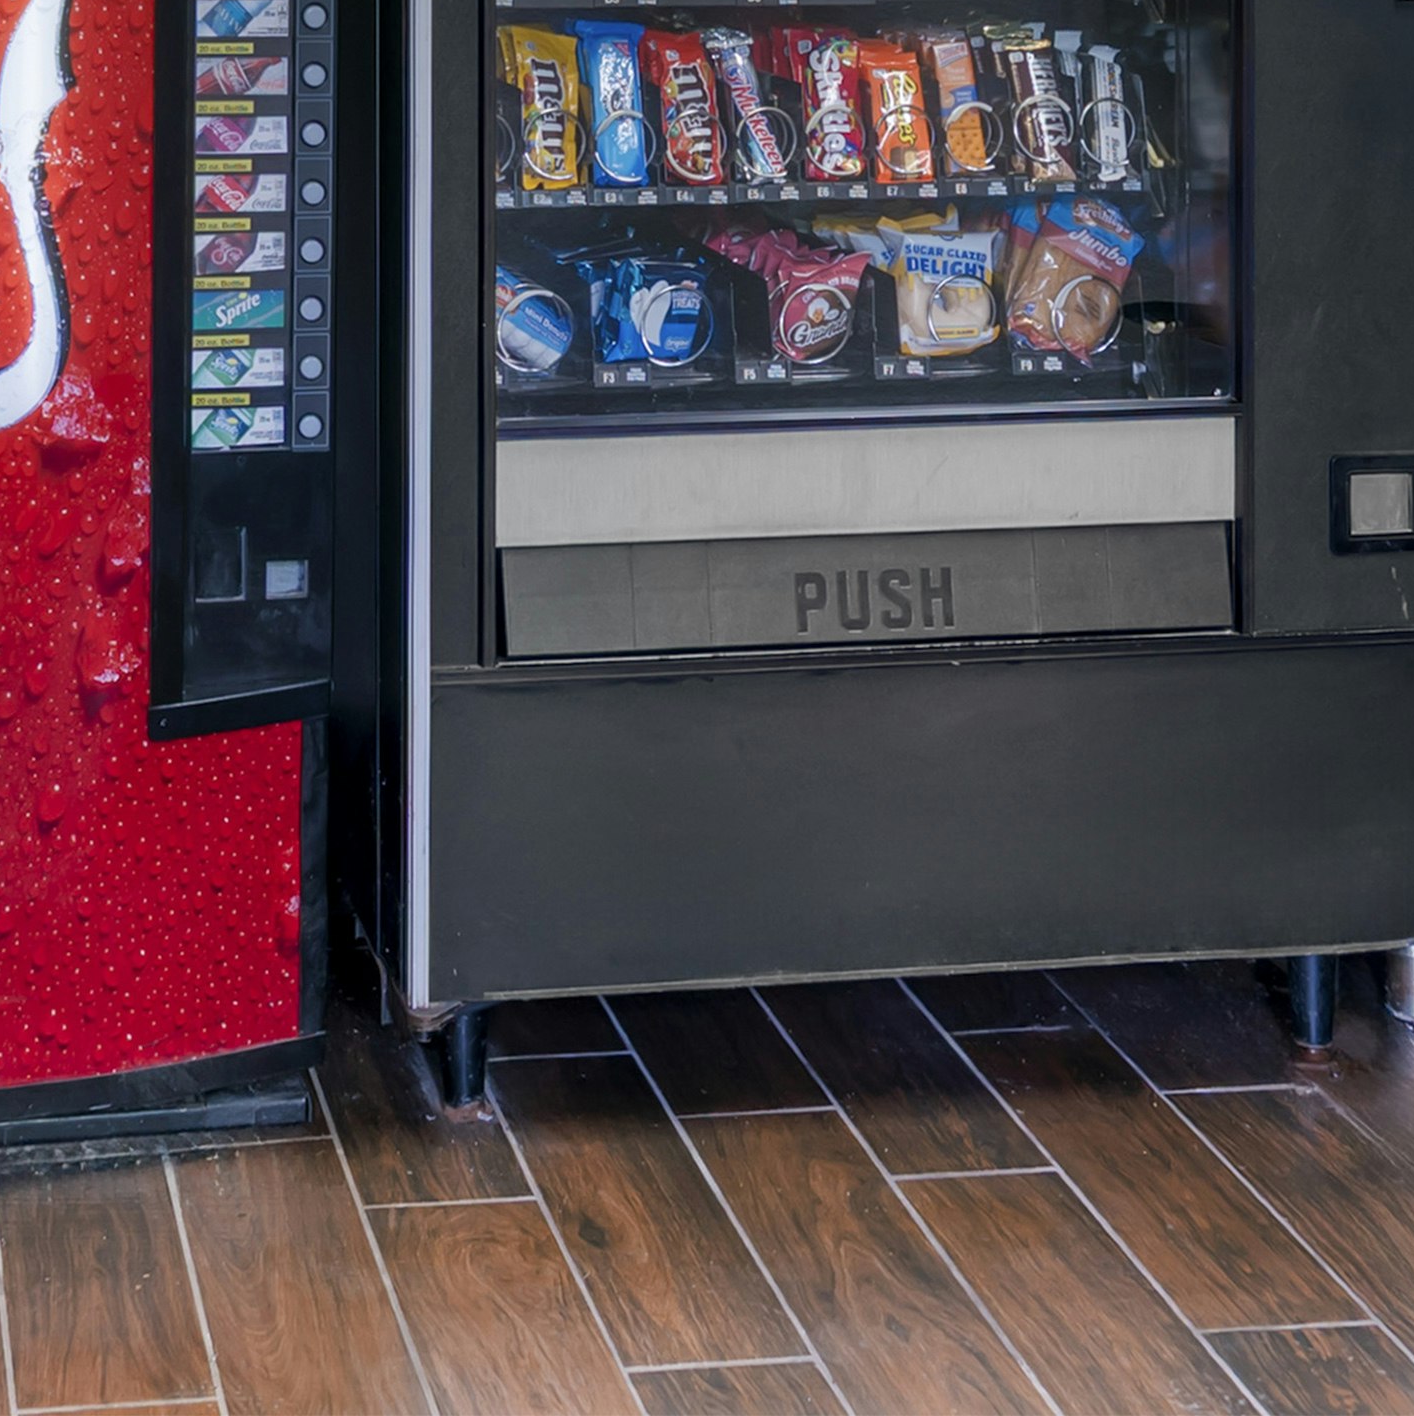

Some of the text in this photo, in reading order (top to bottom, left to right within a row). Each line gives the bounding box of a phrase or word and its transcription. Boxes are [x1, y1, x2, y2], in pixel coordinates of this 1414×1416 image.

[223, 162, 247, 170] Bottle
[604, 192, 617, 203] E3
[747, 189, 760, 200] E5
[816, 187, 830, 199] E6
[886, 186, 899, 197] E7
[904, 243, 988, 262] SUGAR GLAZED
[1068, 229, 1128, 267] Jumbo
[905, 255, 986, 282] DELIGHT
[672, 298, 702, 310] TREATS
[215, 293, 261, 328] Sprite
[744, 368, 756, 380] F5
[883, 364, 895, 376] F7
[603, 371, 616, 384] F3
[196, 397, 206, 405] 20
[222, 396, 246, 404] Bottle
[792, 565, 957, 634] PUSH
